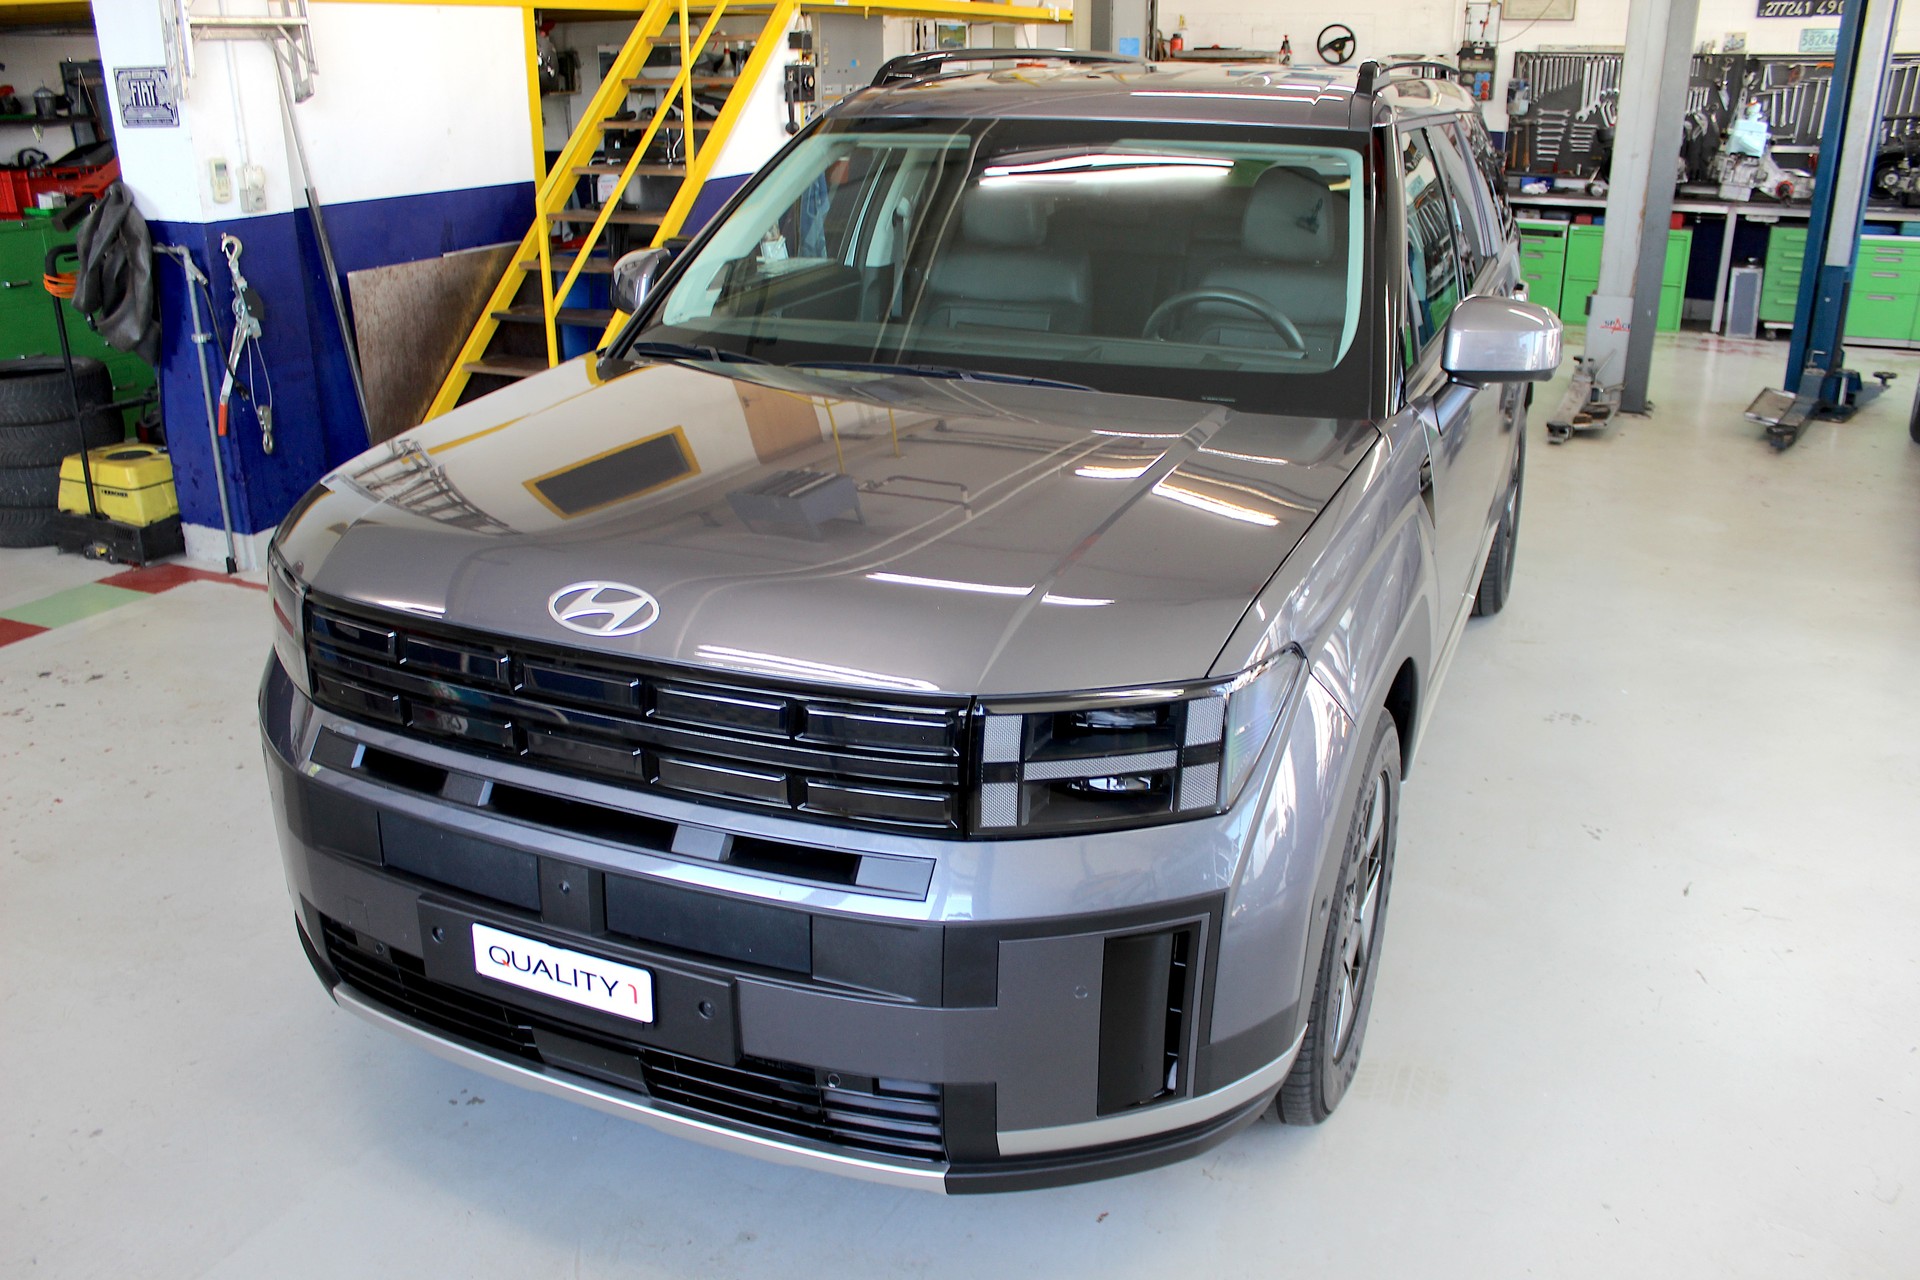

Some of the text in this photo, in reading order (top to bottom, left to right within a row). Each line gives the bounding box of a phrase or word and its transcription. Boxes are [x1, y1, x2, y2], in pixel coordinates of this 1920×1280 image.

[1802, 33, 1839, 47] 582R4
[129, 80, 157, 107] FIAT
[488, 945, 638, 1005] QUALITY 1
